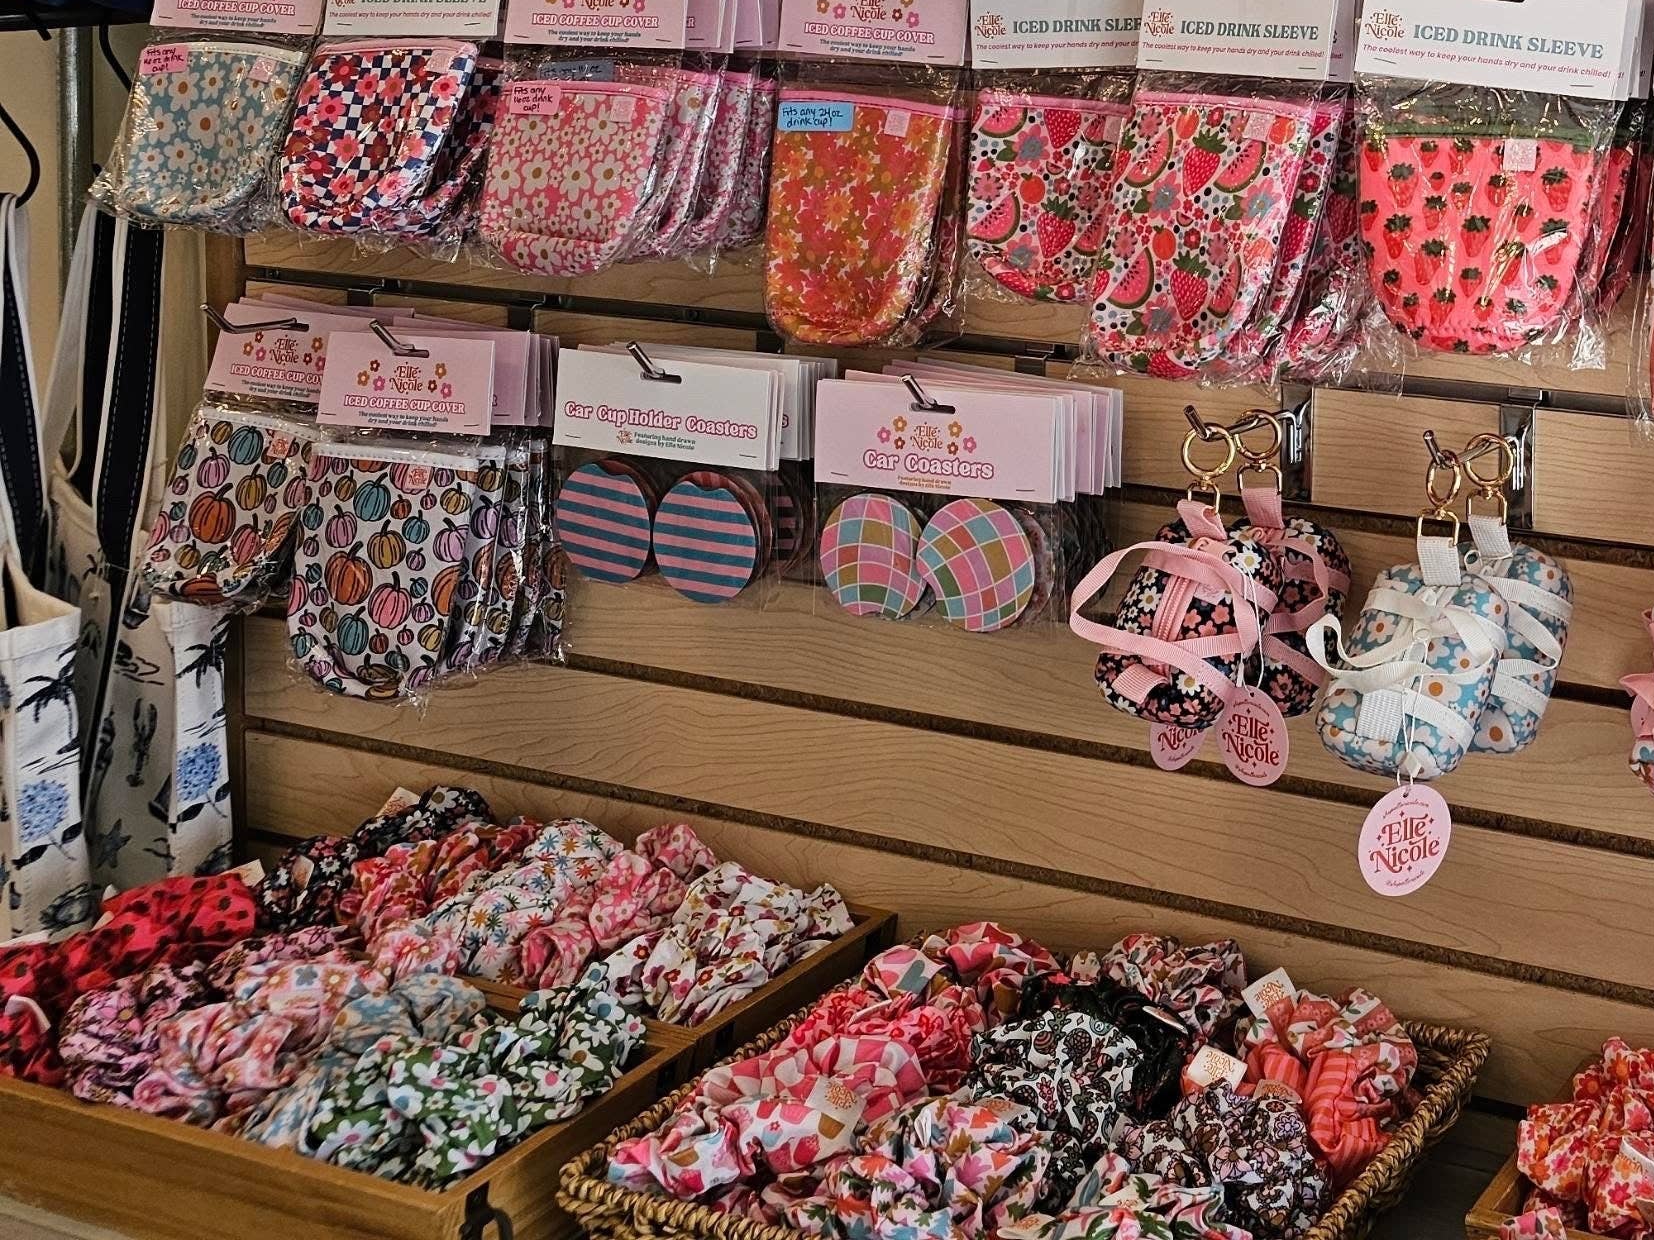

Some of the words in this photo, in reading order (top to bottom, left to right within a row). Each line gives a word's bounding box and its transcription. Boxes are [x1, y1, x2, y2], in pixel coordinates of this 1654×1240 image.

[200, 0, 237, 12] COFFEE
[238, 2, 259, 13] CUP
[260, 3, 296, 16] COVER
[804, 22, 829, 35] ICED
[830, 25, 872, 39] COFFEE
[873, 28, 895, 40] CUP
[896, 30, 935, 44] COVER
[1181, 21, 1214, 35] ICED
[1218, 22, 1261, 37] DRINK
[1264, 24, 1319, 40] SLEEVE
[1414, 24, 1458, 42] ICED
[1463, 29, 1523, 50] DRINK
[1527, 38, 1603, 59] SLEEVE
[565, 401, 593, 419] Car
[597, 405, 627, 427] Cup
[628, 409, 681, 430] Holder
[686, 417, 757, 439] Coasters
[864, 449, 899, 470] Car
[905, 453, 994, 479] Coasters
[1382, 814, 1428, 846] Elle
[1370, 838, 1439, 874] Nicole
